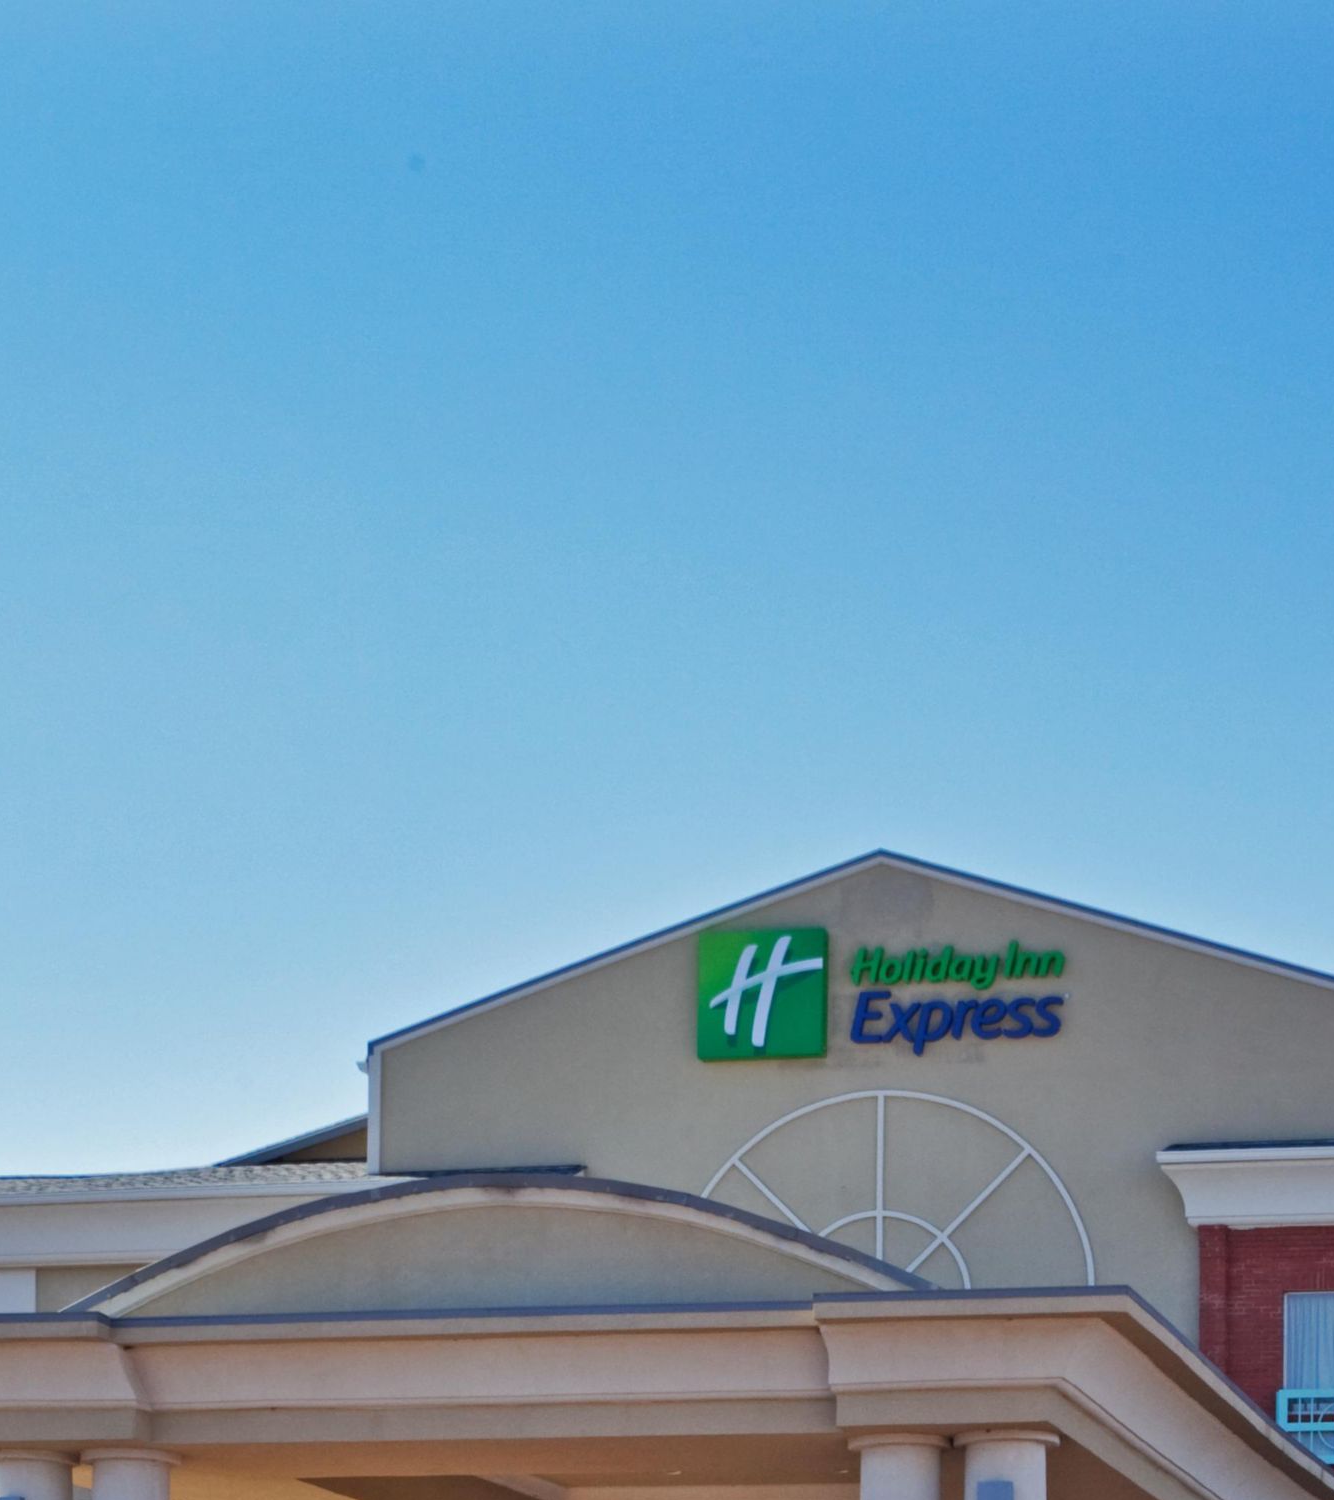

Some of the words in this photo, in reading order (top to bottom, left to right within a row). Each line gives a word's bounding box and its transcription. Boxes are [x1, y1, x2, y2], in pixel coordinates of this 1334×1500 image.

[851, 941, 1001, 989] Holiday
[1002, 940, 1066, 981] Inn
[850, 990, 1065, 1057] Express
